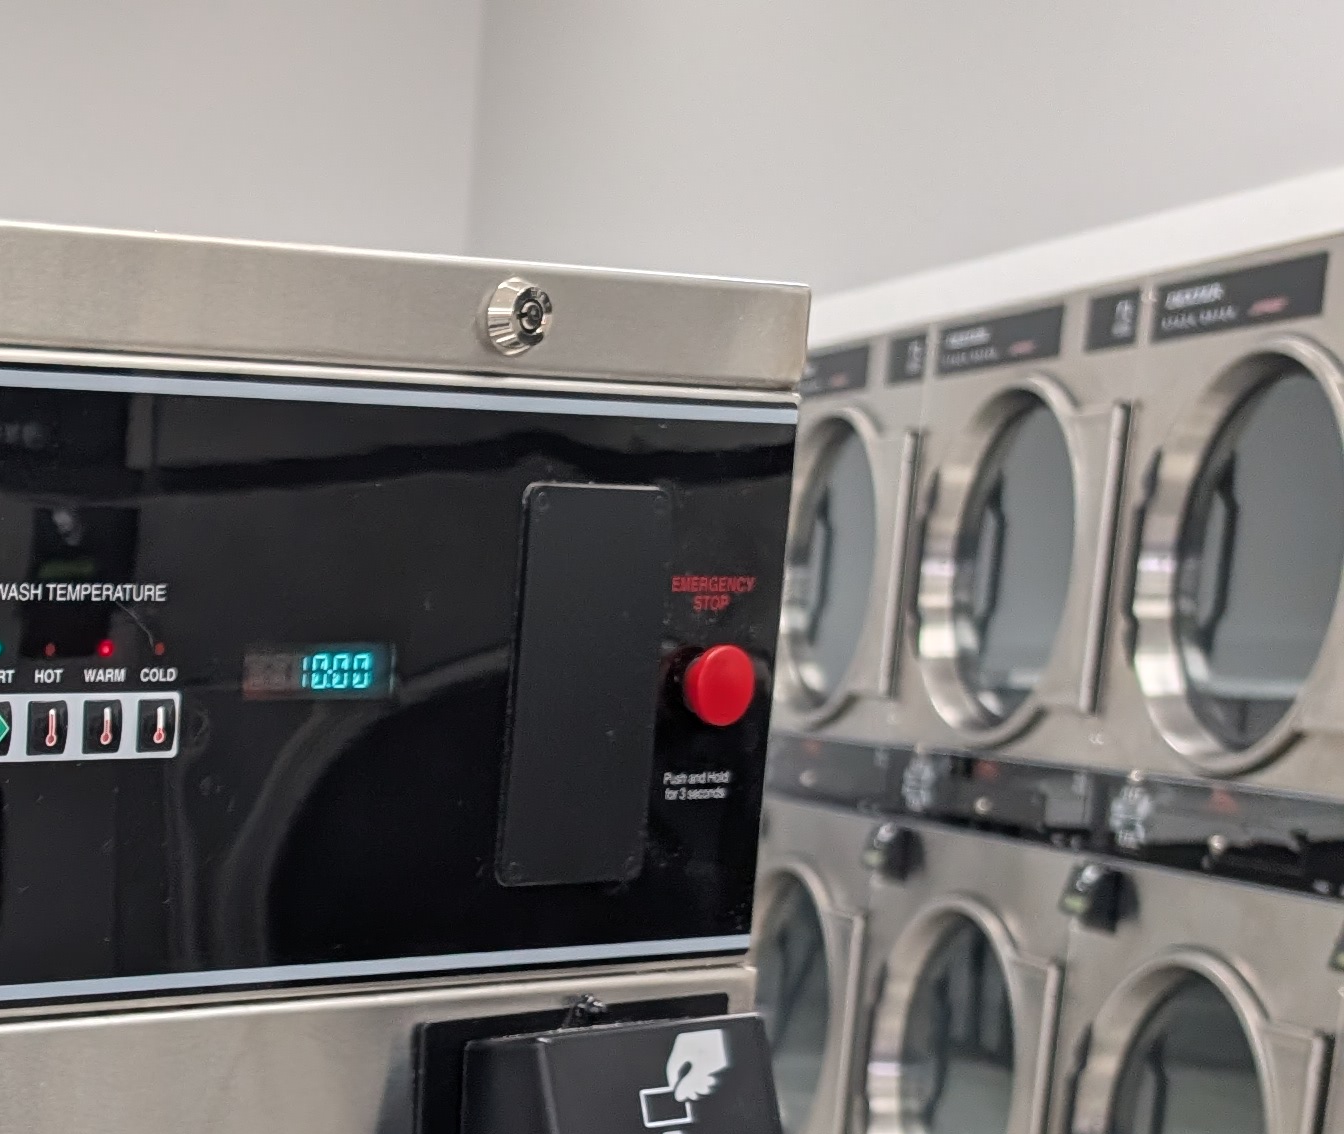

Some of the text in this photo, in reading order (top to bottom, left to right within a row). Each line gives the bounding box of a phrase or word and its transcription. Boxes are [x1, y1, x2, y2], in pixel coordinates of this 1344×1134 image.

[671, 576, 756, 592] EMERGENCY
[46, 583, 167, 602] TEMPERATURE
[693, 594, 731, 612] STOP
[34, 669, 63, 684] HOT
[83, 668, 126, 683] WARM
[139, 667, 177, 682] COLD
